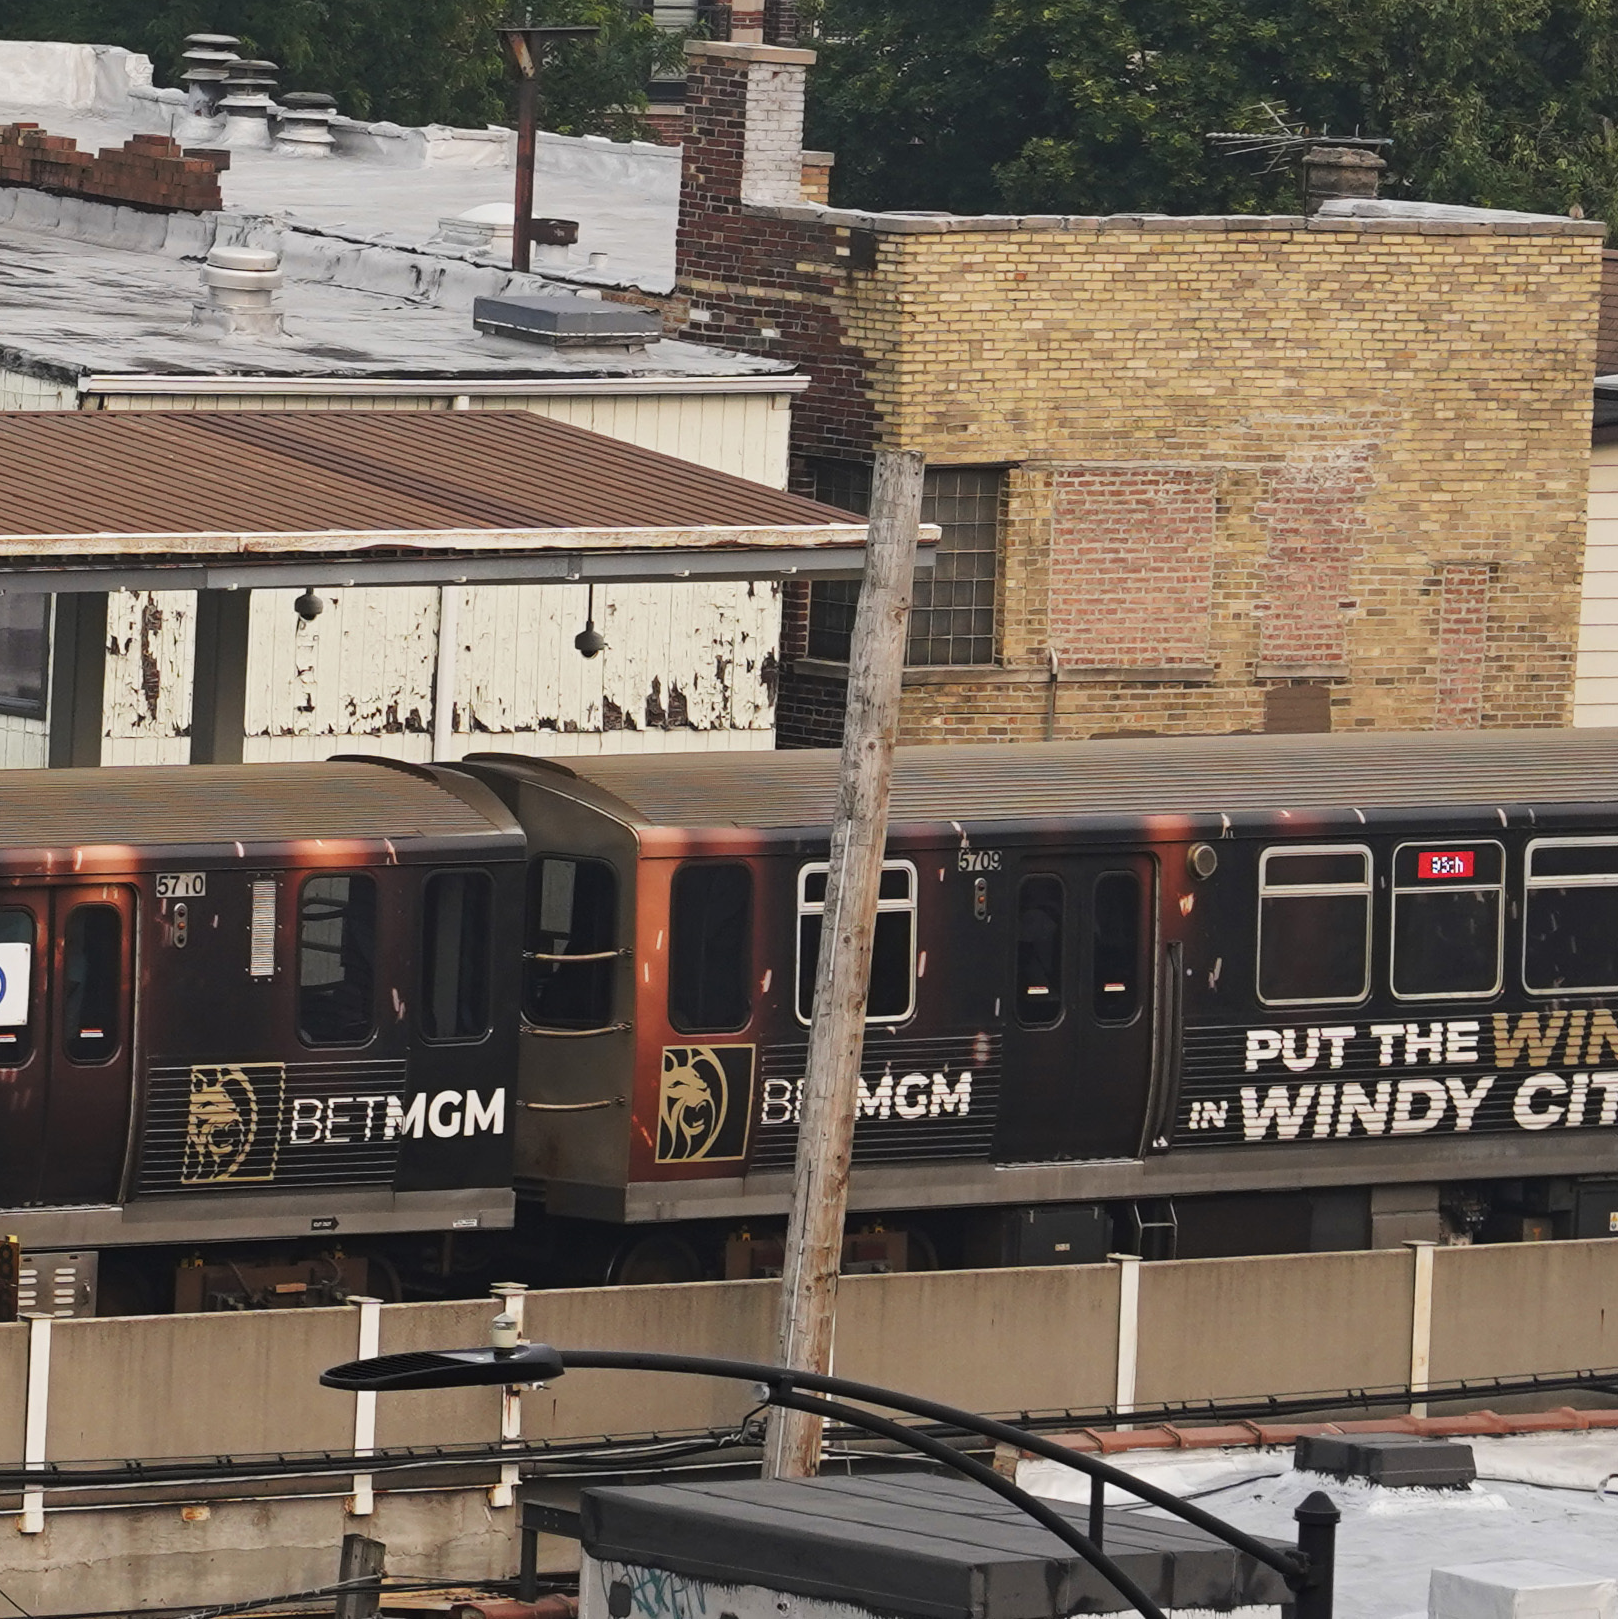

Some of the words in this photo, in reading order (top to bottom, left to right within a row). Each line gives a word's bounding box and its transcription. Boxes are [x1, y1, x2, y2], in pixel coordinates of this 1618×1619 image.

[157, 875, 204, 895] 5710
[959, 851, 1001, 871] 5709
[1245, 1026, 1357, 1073] PUT
[1369, 1021, 1480, 1067] THE
[290, 1087, 506, 1144] BETMGM
[761, 1072, 972, 1124] BMGM
[1189, 1100, 1229, 1130] IN
[1239, 1075, 1498, 1141] WINDY
[1512, 1072, 1618, 1131] CIT
